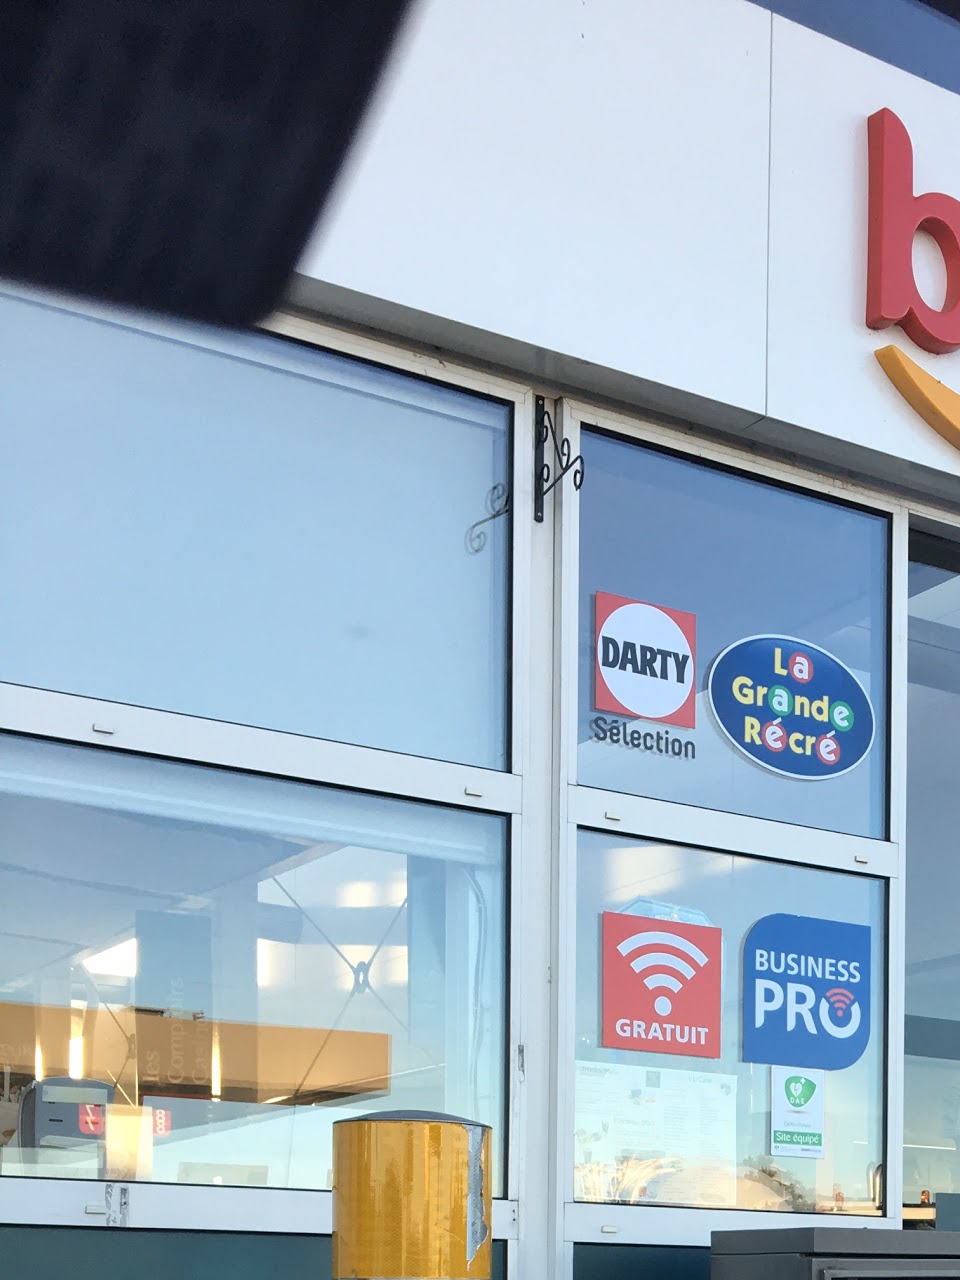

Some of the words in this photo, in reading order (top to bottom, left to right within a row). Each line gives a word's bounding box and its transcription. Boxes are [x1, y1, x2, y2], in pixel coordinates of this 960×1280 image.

[601, 635, 690, 684] DARTY
[774, 647, 810, 680] La
[731, 676, 850, 728] Grande
[592, 716, 696, 759] Sélection
[744, 715, 837, 761] Récré
[755, 949, 861, 983] BUSINESS
[754, 978, 862, 1039] PRO
[615, 1018, 709, 1045] GRATUIT
[776, 1131, 791, 1143] Site
[792, 1133, 820, 1146] équipé
